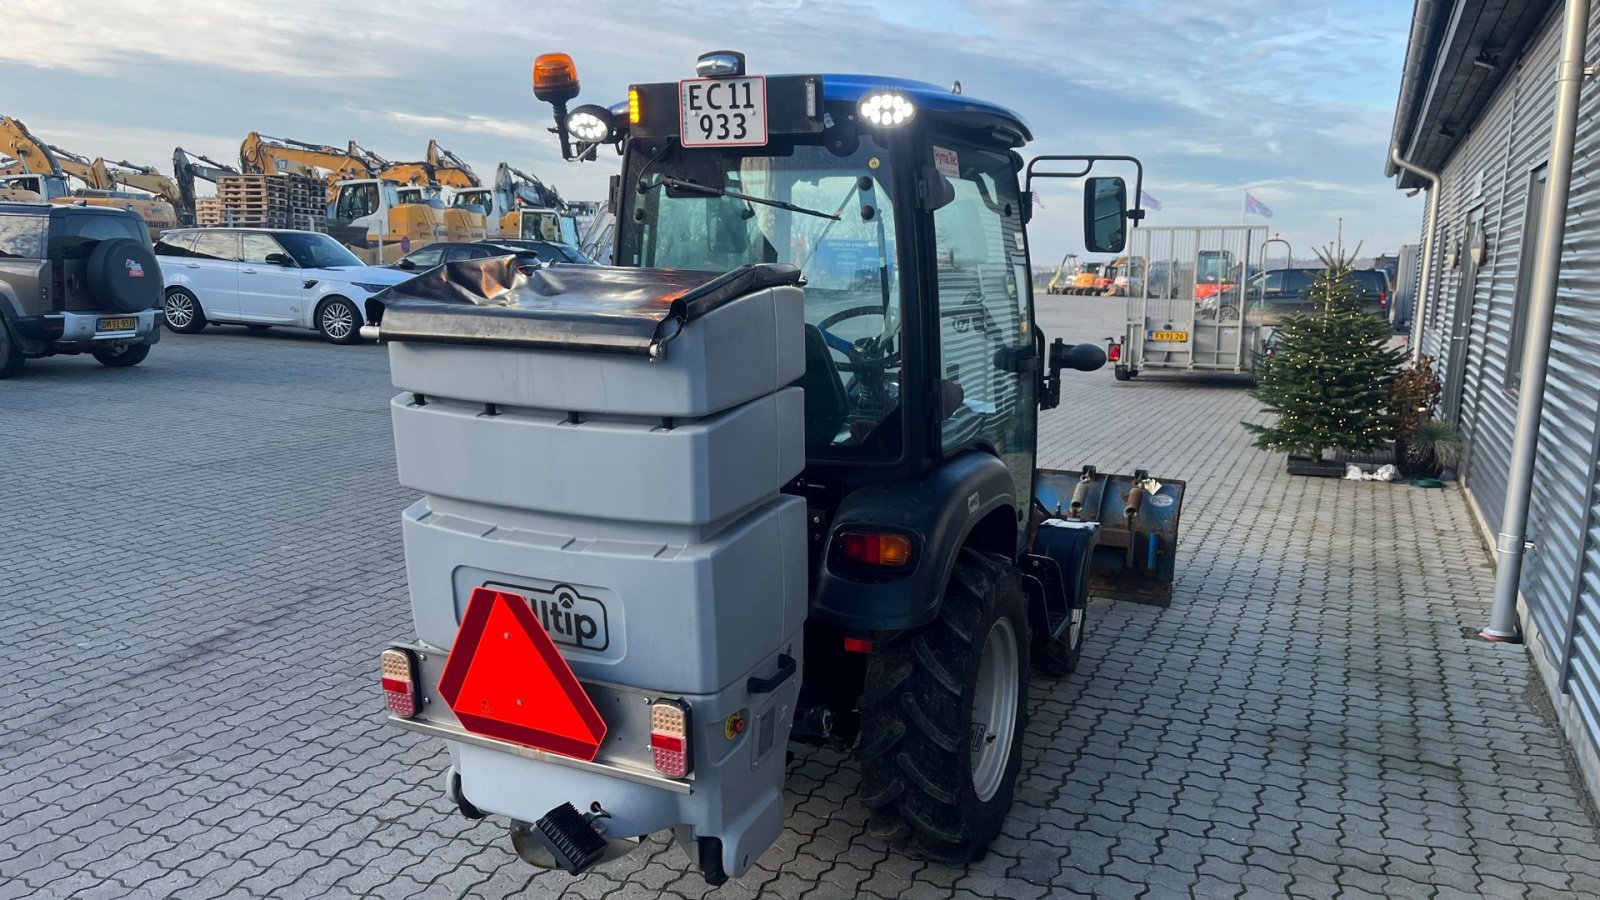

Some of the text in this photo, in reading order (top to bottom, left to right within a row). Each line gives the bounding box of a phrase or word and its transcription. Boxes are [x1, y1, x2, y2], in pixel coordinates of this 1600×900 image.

[689, 82, 755, 110] EC 11
[699, 113, 747, 140] 933
[523, 592, 598, 647] lltip
